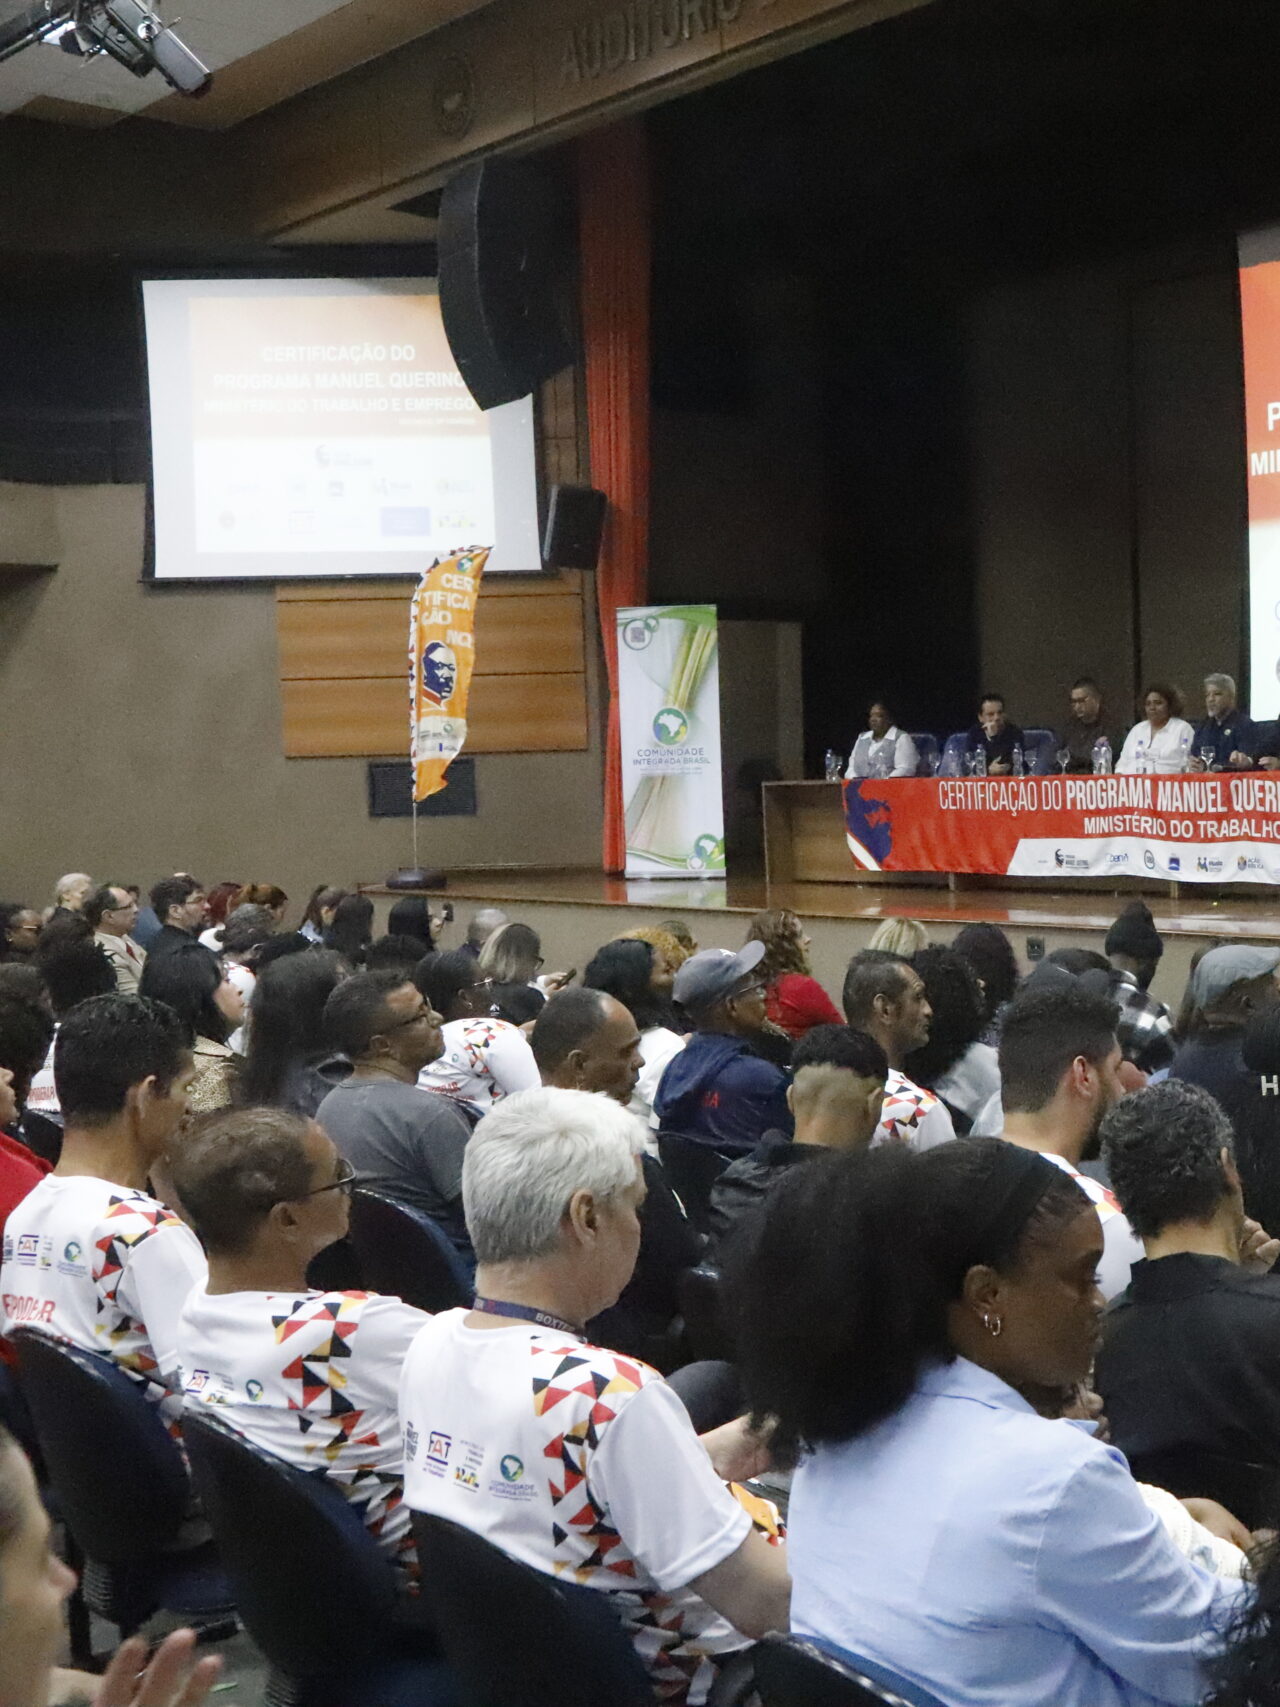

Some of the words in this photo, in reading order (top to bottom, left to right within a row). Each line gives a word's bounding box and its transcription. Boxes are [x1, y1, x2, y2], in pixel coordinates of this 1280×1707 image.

[390, 345, 416, 362] DO
[315, 371, 386, 388] MANUEL
[442, 574, 475, 592] CER
[637, 747, 704, 757] COMUNIDADE
[632, 758, 681, 766] INTEGRADA
[938, 776, 1037, 816] CERTIFICAÇÃO
[1042, 780, 1061, 810] DO
[1066, 777, 1153, 810] PROGRAMA
[1157, 780, 1229, 813] MANUEL
[1084, 811, 1166, 836] MINISTÉRIO
[1171, 819, 1194, 838] DO
[427, 1432, 452, 1459] FAT
